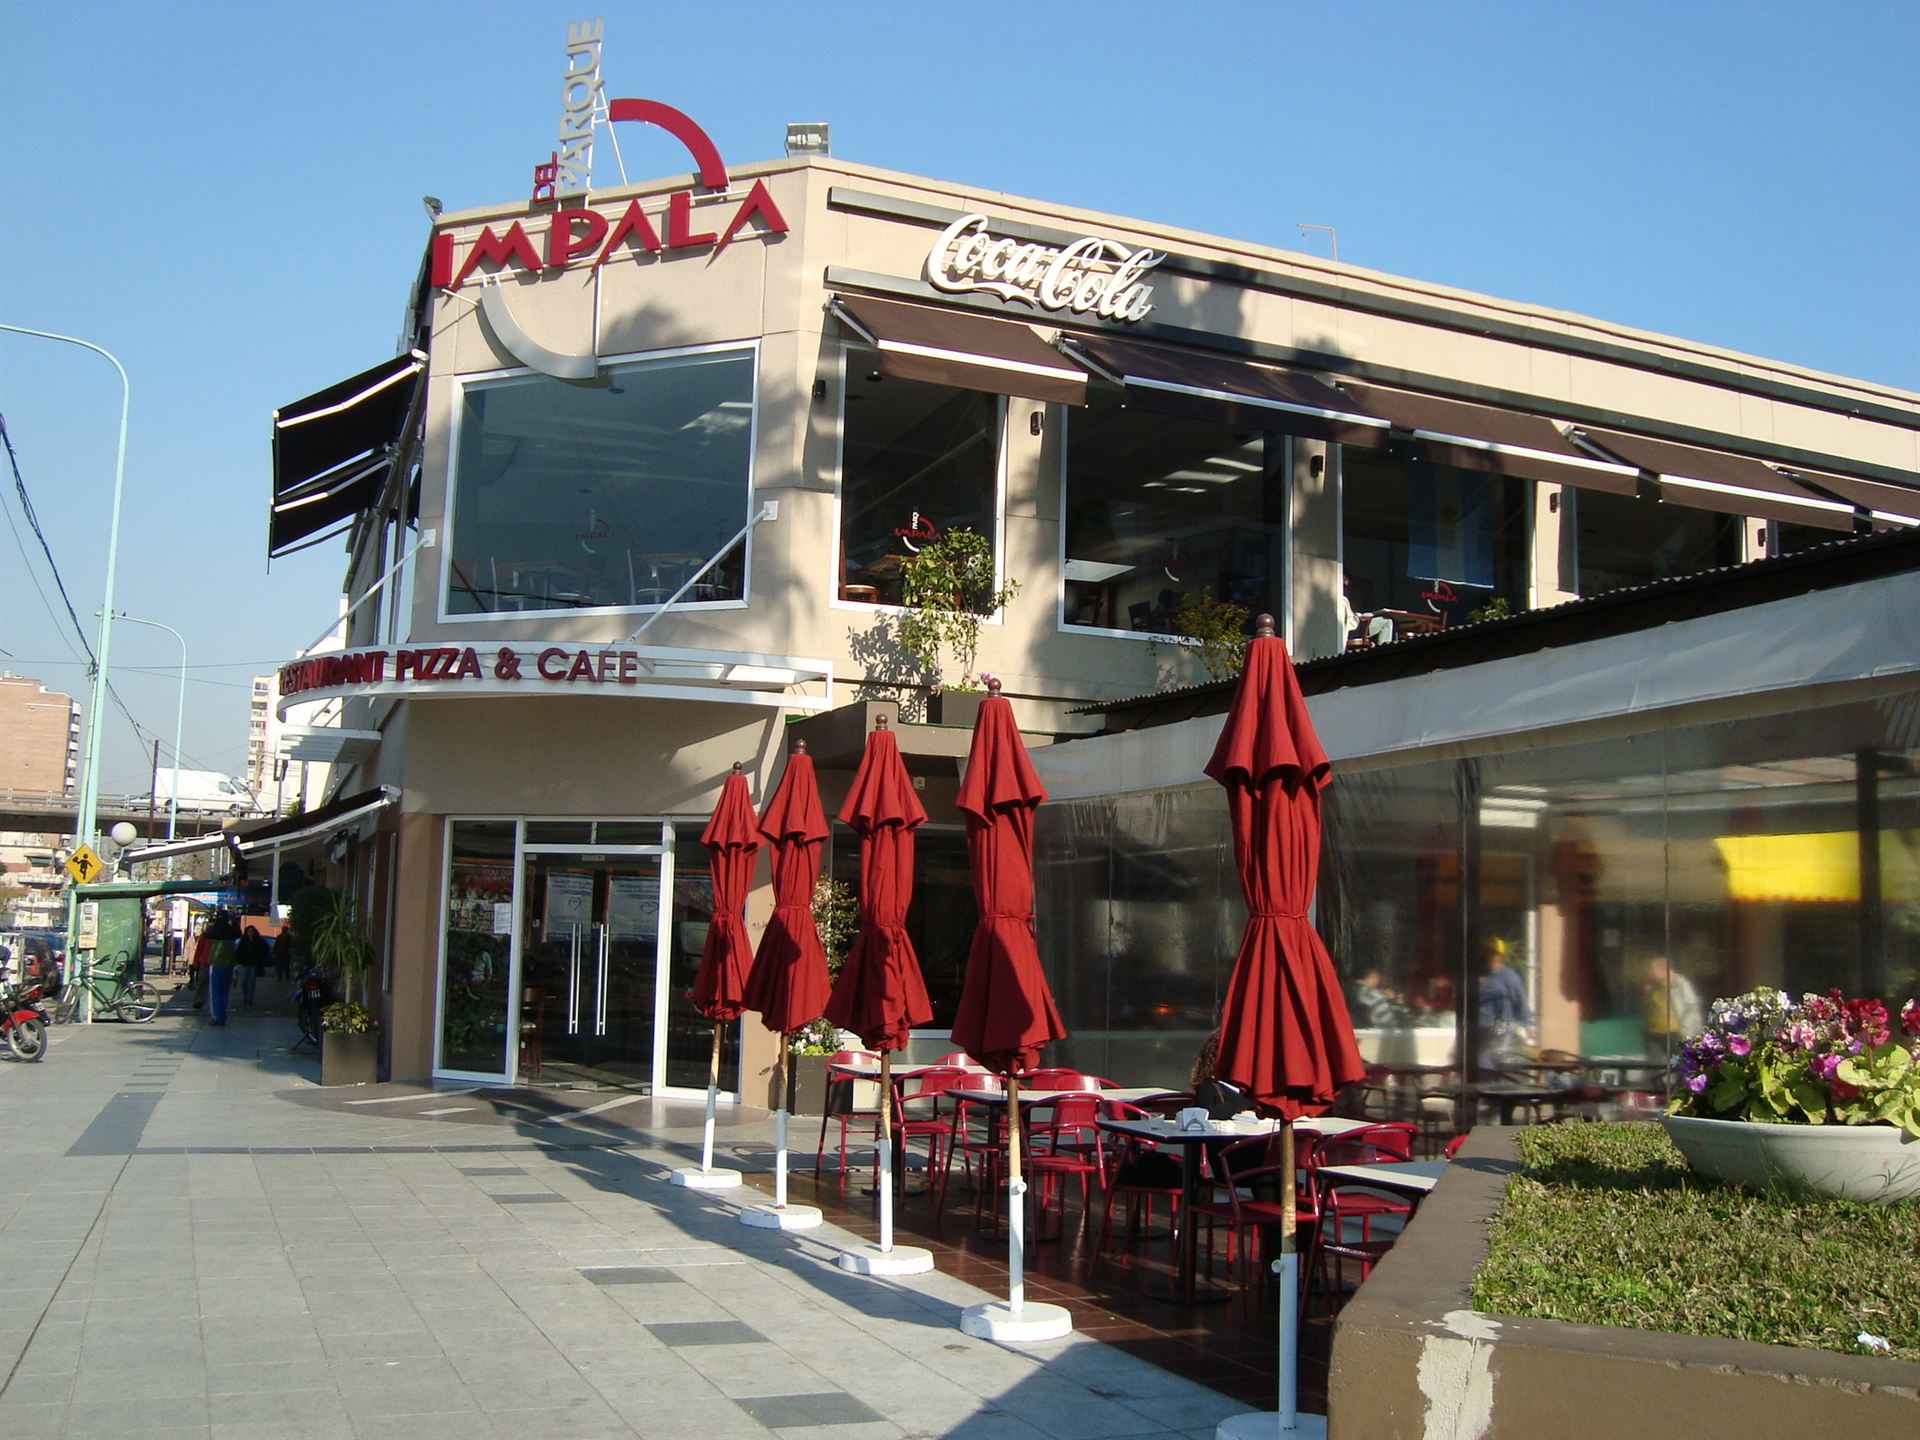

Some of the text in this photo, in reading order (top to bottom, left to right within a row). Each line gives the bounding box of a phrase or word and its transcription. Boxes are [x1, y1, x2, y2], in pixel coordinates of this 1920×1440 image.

[554, 16, 604, 199] PARQUE
[533, 151, 558, 202] DEL
[432, 178, 789, 293] IMPALA
[278, 647, 638, 696] RESTAURANT PIZZA & CAFE
